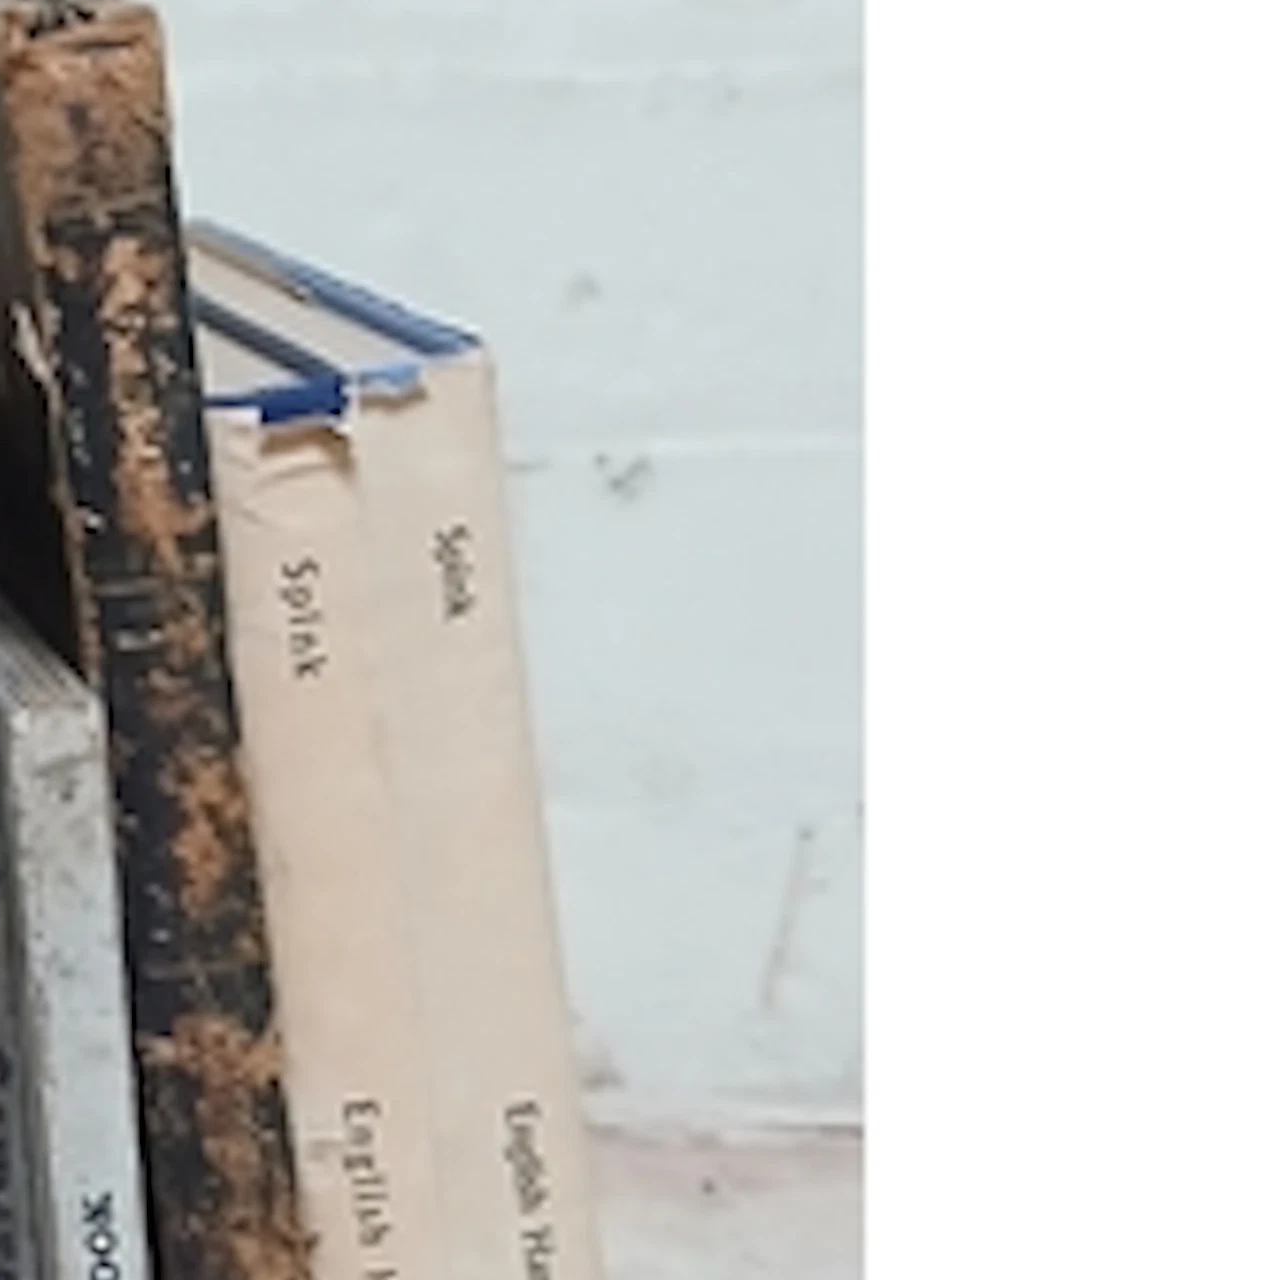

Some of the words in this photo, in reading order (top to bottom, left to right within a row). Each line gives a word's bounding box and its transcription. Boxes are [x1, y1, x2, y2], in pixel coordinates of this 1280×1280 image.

[278, 556, 328, 681] Spink
[433, 524, 476, 623] Spink
[342, 1099, 392, 1248] English
[504, 1099, 549, 1216] English
